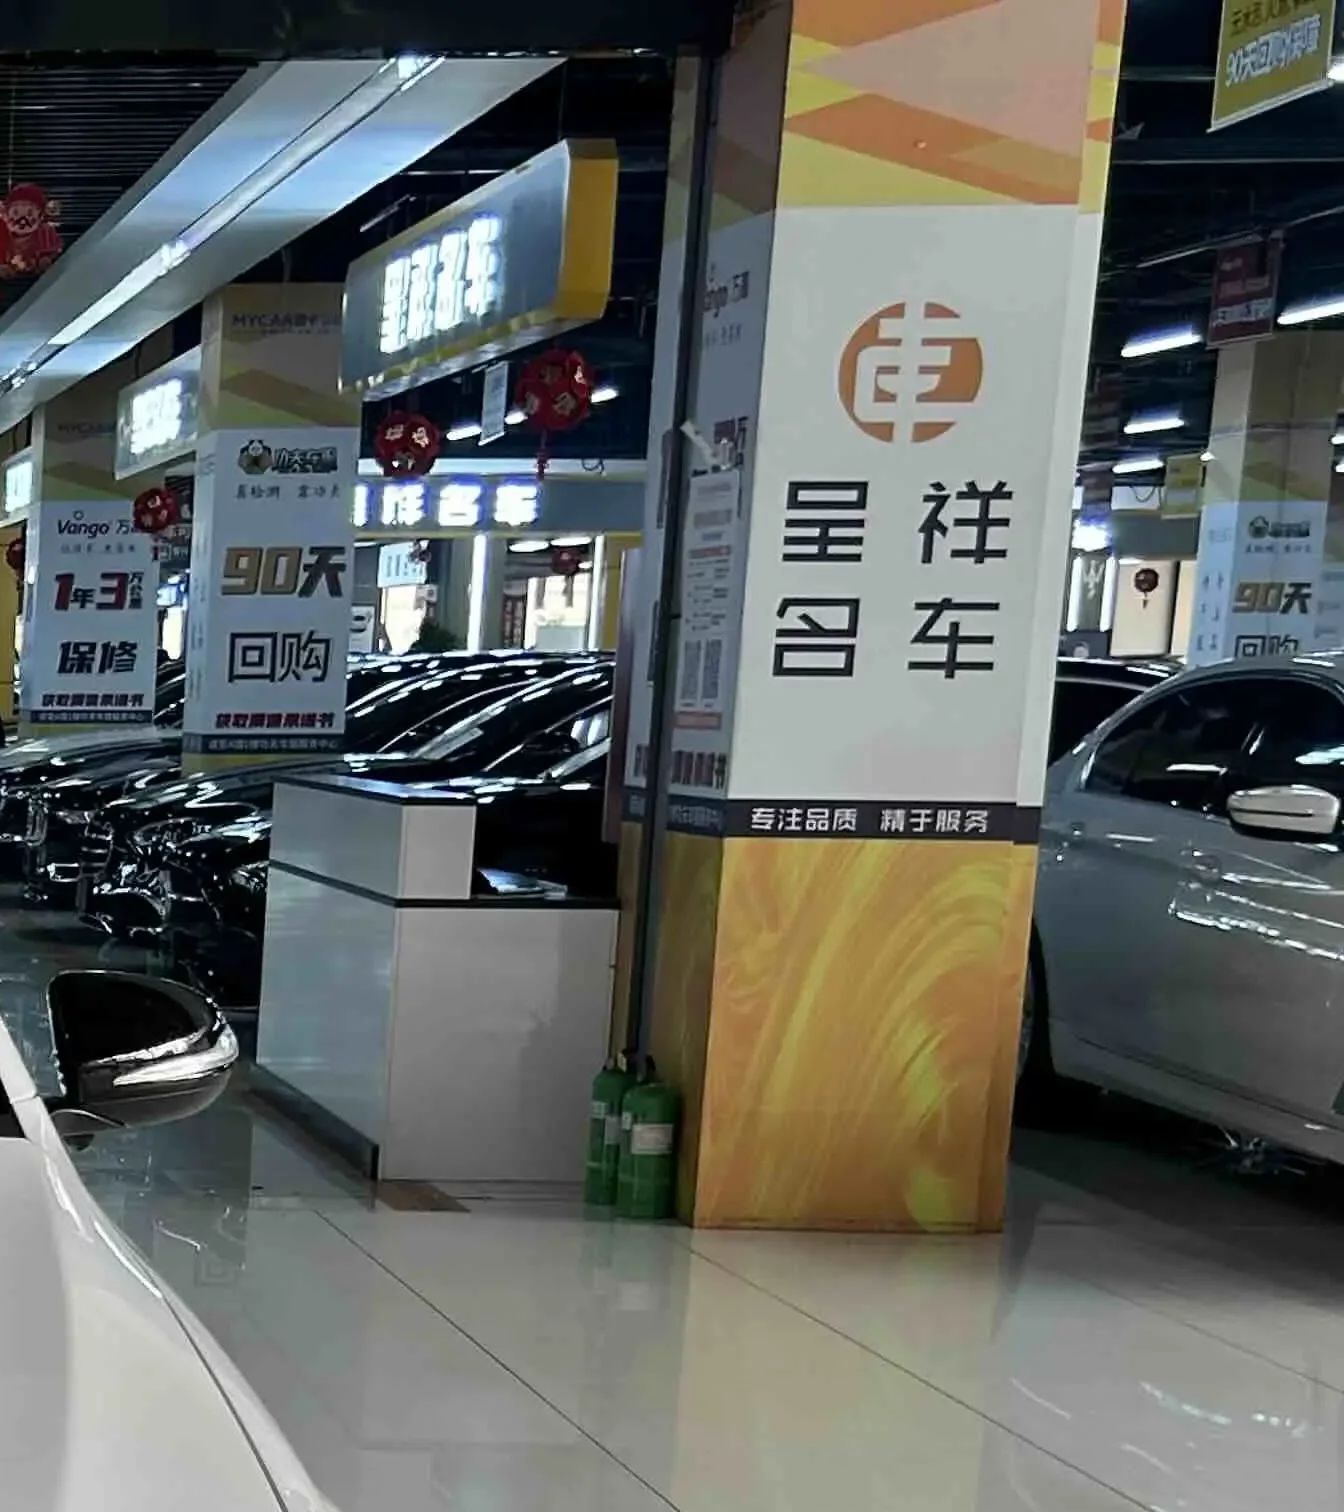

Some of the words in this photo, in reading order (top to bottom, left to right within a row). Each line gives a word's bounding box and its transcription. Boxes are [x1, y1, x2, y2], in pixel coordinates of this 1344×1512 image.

[57, 519, 110, 539] Vango
[221, 546, 346, 598] 90天
[1232, 582, 1312, 615] 90天
[228, 629, 332, 683] 回购
[772, 597, 1000, 680] 名车
[57, 639, 138, 674] 保修
[750, 807, 858, 833] 专注品质
[880, 808, 989, 834] 精于服务
